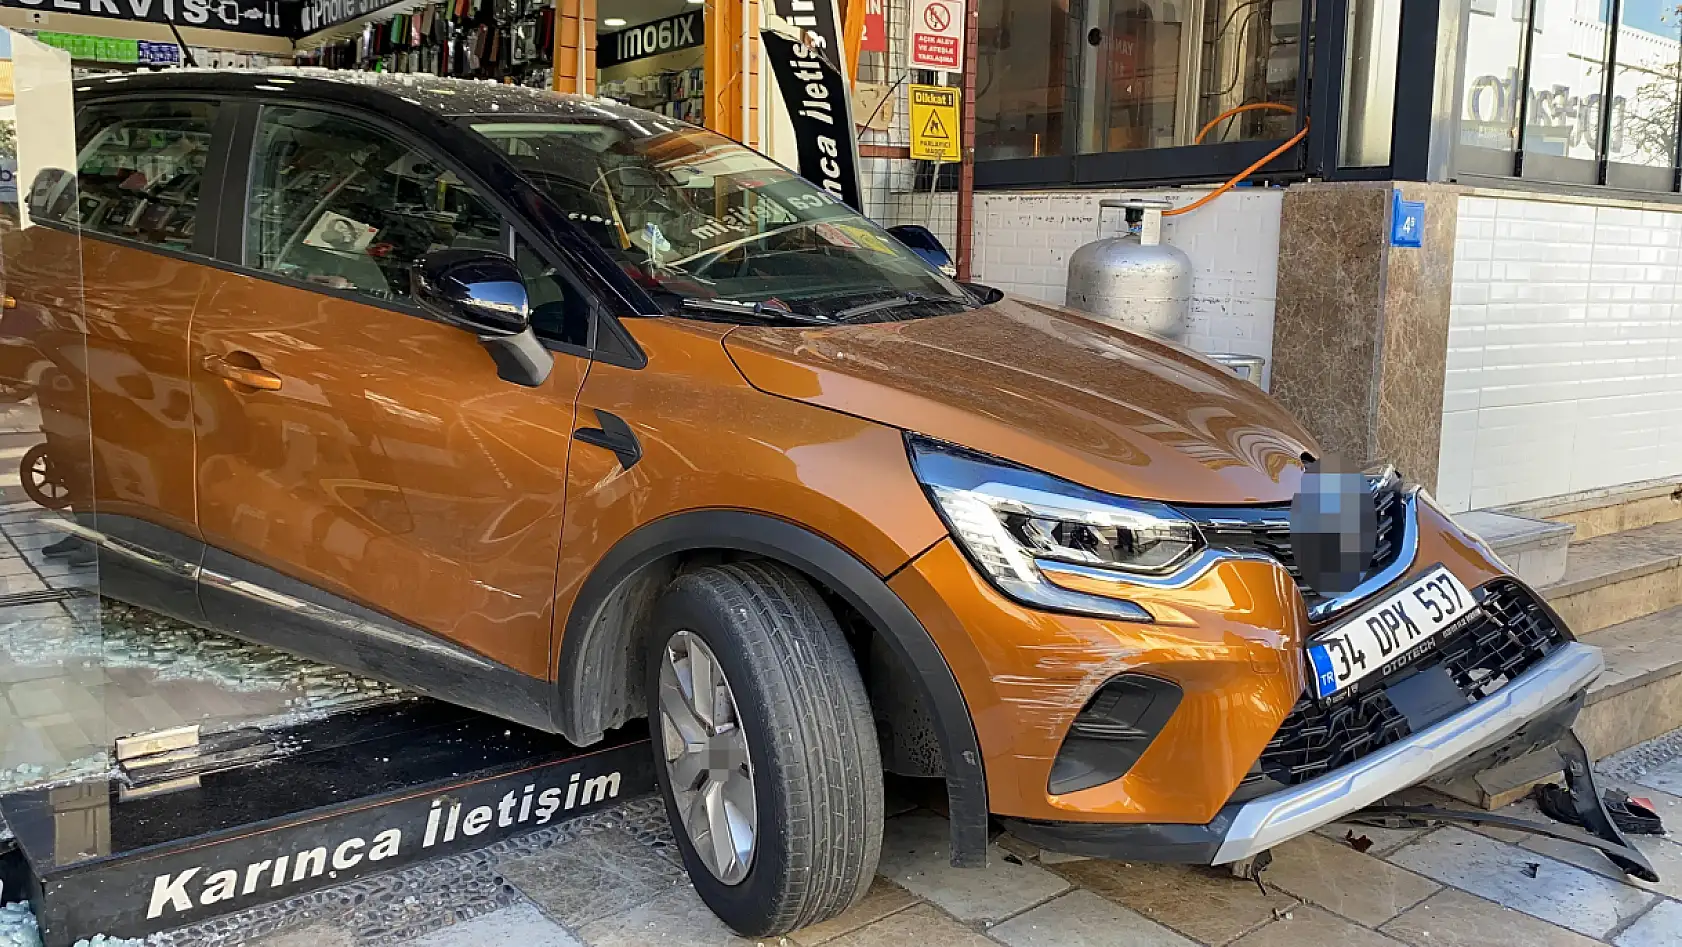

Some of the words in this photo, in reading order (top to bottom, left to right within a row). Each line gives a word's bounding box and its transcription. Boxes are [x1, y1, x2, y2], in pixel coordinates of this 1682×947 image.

[19, 0, 210, 24] RVIS
[918, 43, 928, 51] VE
[915, 92, 946, 106] Dikkat
[1412, 573, 1464, 624] 537
[1327, 632, 1367, 682] 34
[1382, 637, 1436, 676] OTOTECH
[1320, 671, 1335, 687] TR
[422, 771, 622, 849] İletişim
